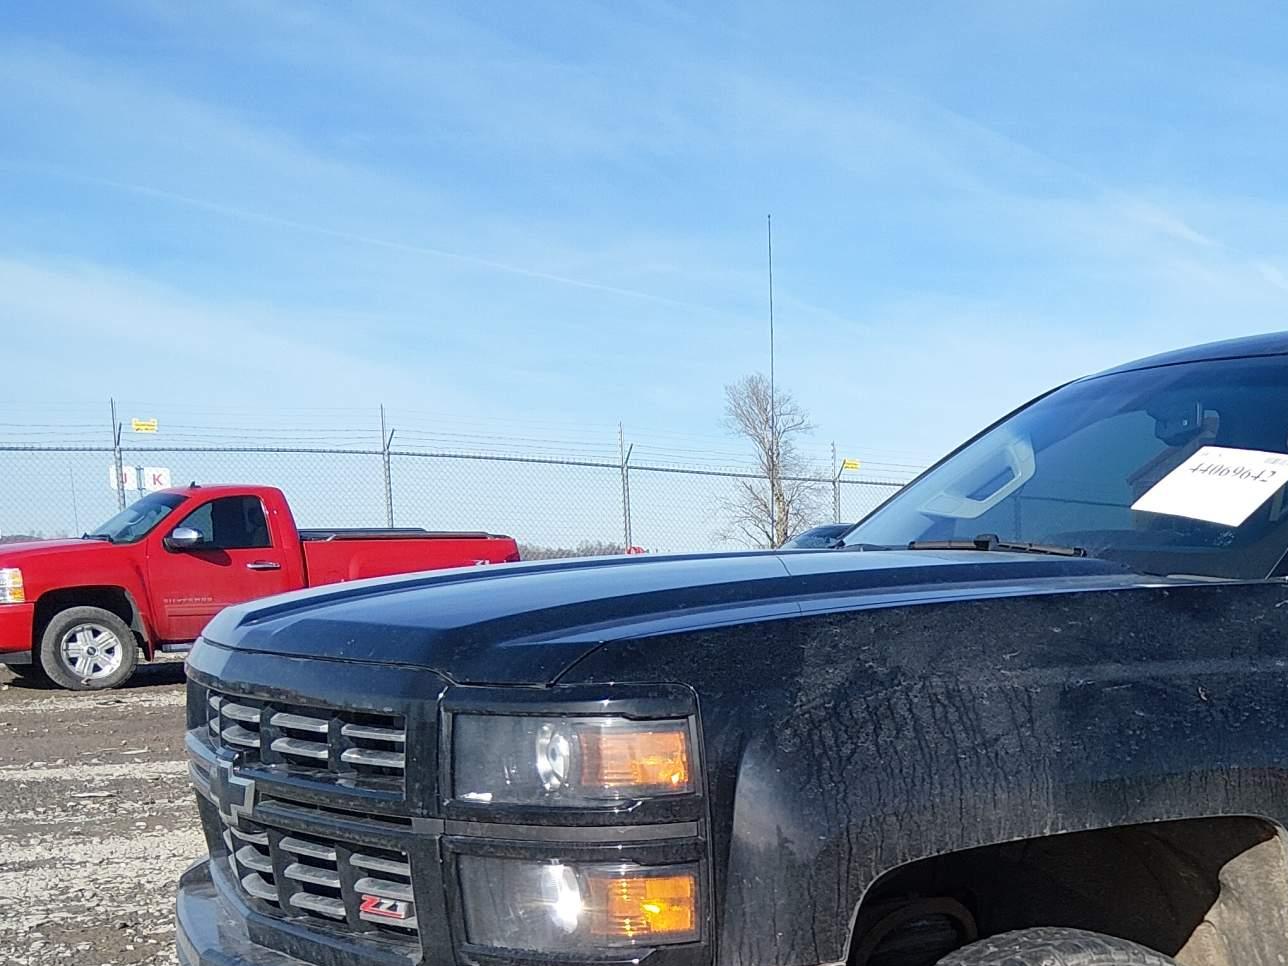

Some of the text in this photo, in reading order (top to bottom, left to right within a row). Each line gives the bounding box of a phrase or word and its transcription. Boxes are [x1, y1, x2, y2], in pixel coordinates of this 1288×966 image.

[152, 473, 163, 486] K
[1189, 462, 1277, 482] 44069642
[360, 894, 408, 920] Z71
